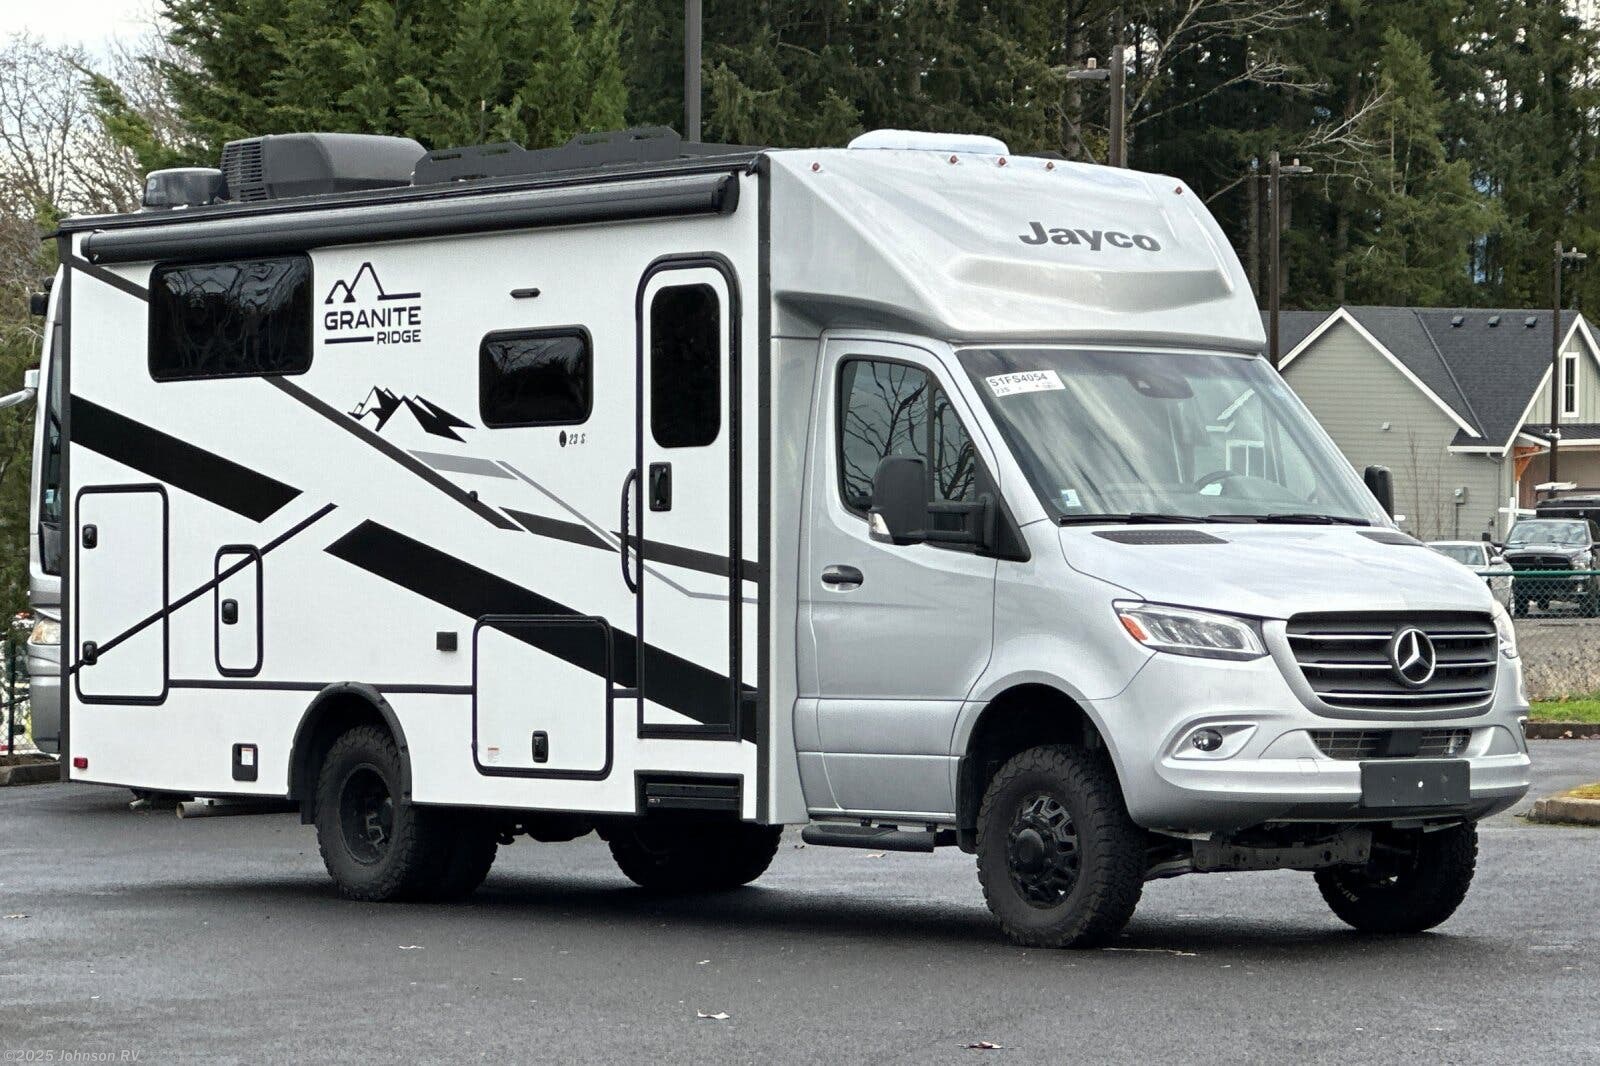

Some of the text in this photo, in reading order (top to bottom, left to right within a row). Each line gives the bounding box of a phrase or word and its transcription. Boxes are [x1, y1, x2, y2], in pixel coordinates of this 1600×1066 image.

[1019, 221, 1161, 251] Jayco
[324, 306, 421, 330] GRANITE
[377, 330, 421, 344] RIDGE
[989, 372, 1048, 387] S1FS4054
